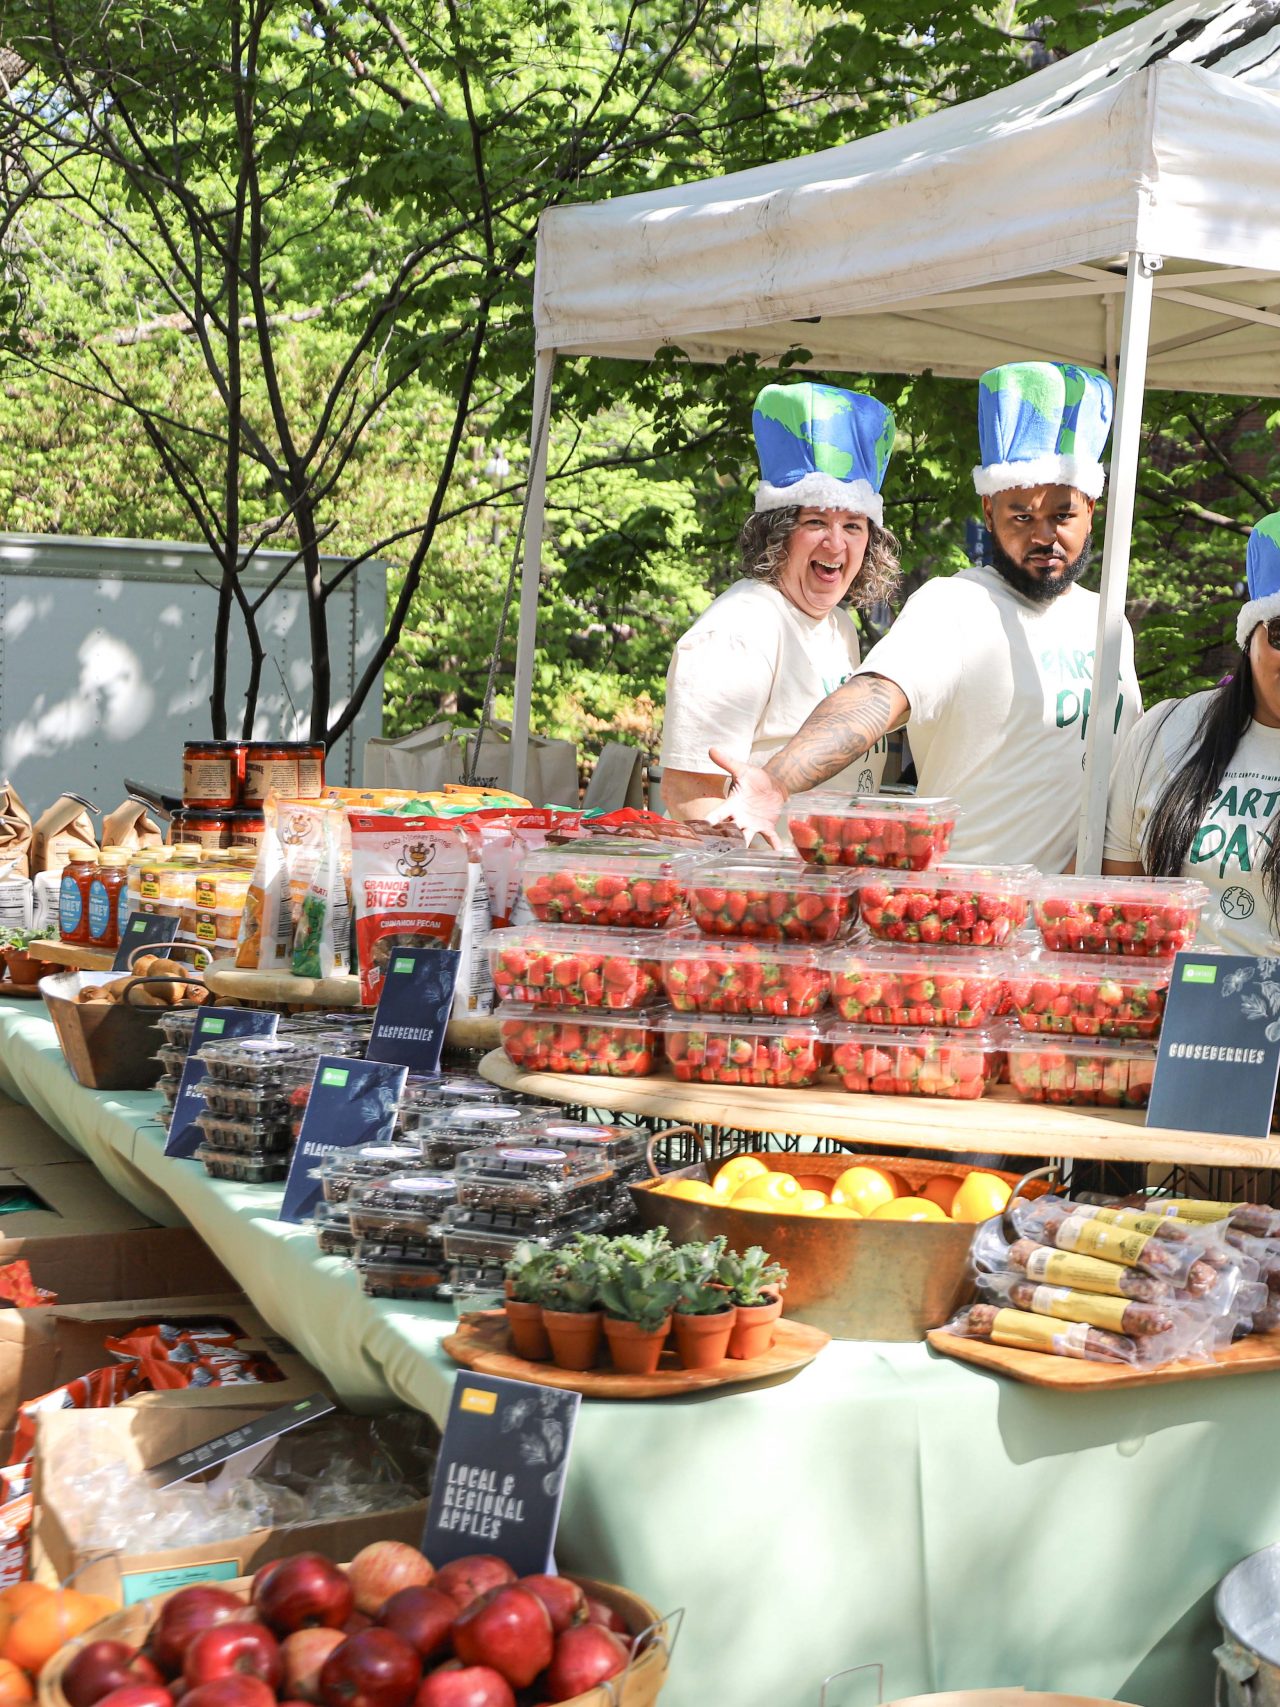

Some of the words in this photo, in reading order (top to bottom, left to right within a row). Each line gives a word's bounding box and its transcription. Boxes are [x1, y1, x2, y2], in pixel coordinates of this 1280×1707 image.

[364, 880, 410, 892] GRANOLA
[380, 919, 416, 929] CINNAMON
[416, 919, 441, 929] PECAN
[378, 1025, 434, 1042] RASPBERRIES
[1168, 1042, 1265, 1064] GOOSEBERRIES
[447, 1462, 497, 1493] LOCAL
[502, 1474, 515, 1495] &
[443, 1485, 525, 1522] REGIONAL
[438, 1506, 502, 1539] APPLES
